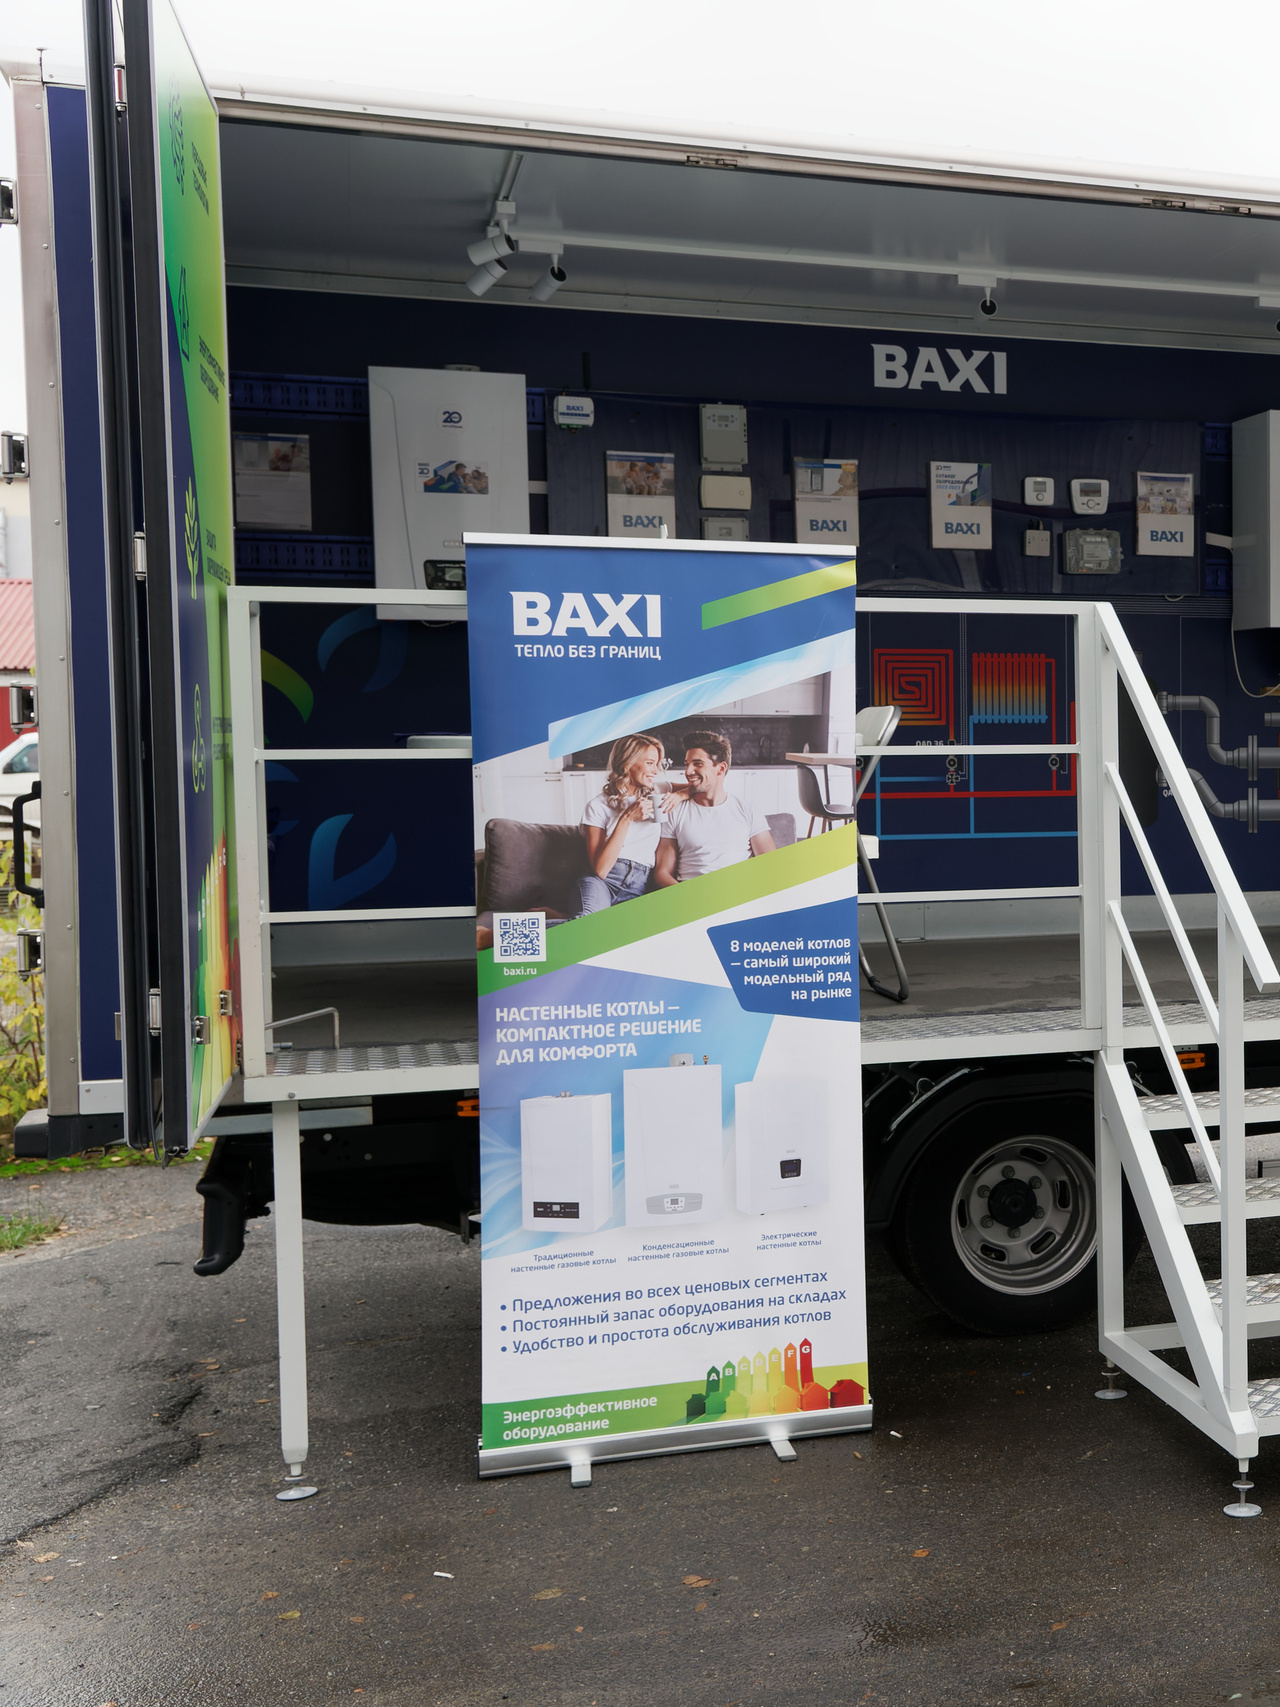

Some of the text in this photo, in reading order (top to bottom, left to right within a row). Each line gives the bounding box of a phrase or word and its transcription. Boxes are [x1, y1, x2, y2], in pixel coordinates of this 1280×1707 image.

[870, 343, 1007, 394] BAXI
[623, 515, 663, 528] BAXI
[809, 519, 847, 532] BAXI
[944, 522, 980, 535] BAXI
[1150, 530, 1183, 542] BAXI
[509, 591, 661, 638] BAXI
[514, 644, 661, 660] ТЕПЛО БЕЗ ГРАНИЦ
[730, 938, 851, 953] 8 моделей котлов
[744, 955, 789, 968] самый
[793, 952, 851, 968] широкий
[503, 966, 537, 975] baxi.ru
[744, 970, 852, 986] модельный ряд
[791, 988, 852, 1002] на рынке
[496, 1004, 602, 1022] НАСТЕННЫЕ
[606, 1000, 664, 1017] КОТЛЫ
[496, 1019, 701, 1043] КОМПАКТНОЕ РЕШЕНИЕ
[496, 1043, 637, 1065] ДЛЯ КОМФОРТА
[761, 1231, 817, 1241] Электрические
[642, 1239, 715, 1251] Конденсационные
[756, 1241, 797, 1250] настенные
[533, 1250, 594, 1262] Традиционные
[627, 1247, 730, 1262] настенные газовые котлы
[510, 1258, 617, 1273] настенные газовые котлы
[513, 1272, 828, 1313] Предложения во всех ценовых сегментах
[513, 1290, 846, 1332] Постоянный запас оборудования на складах
[513, 1311, 832, 1354] Удобство и простота обслуживания котлов
[503, 1396, 658, 1423] Энергоэффективное
[503, 1419, 609, 1440] оборудование
